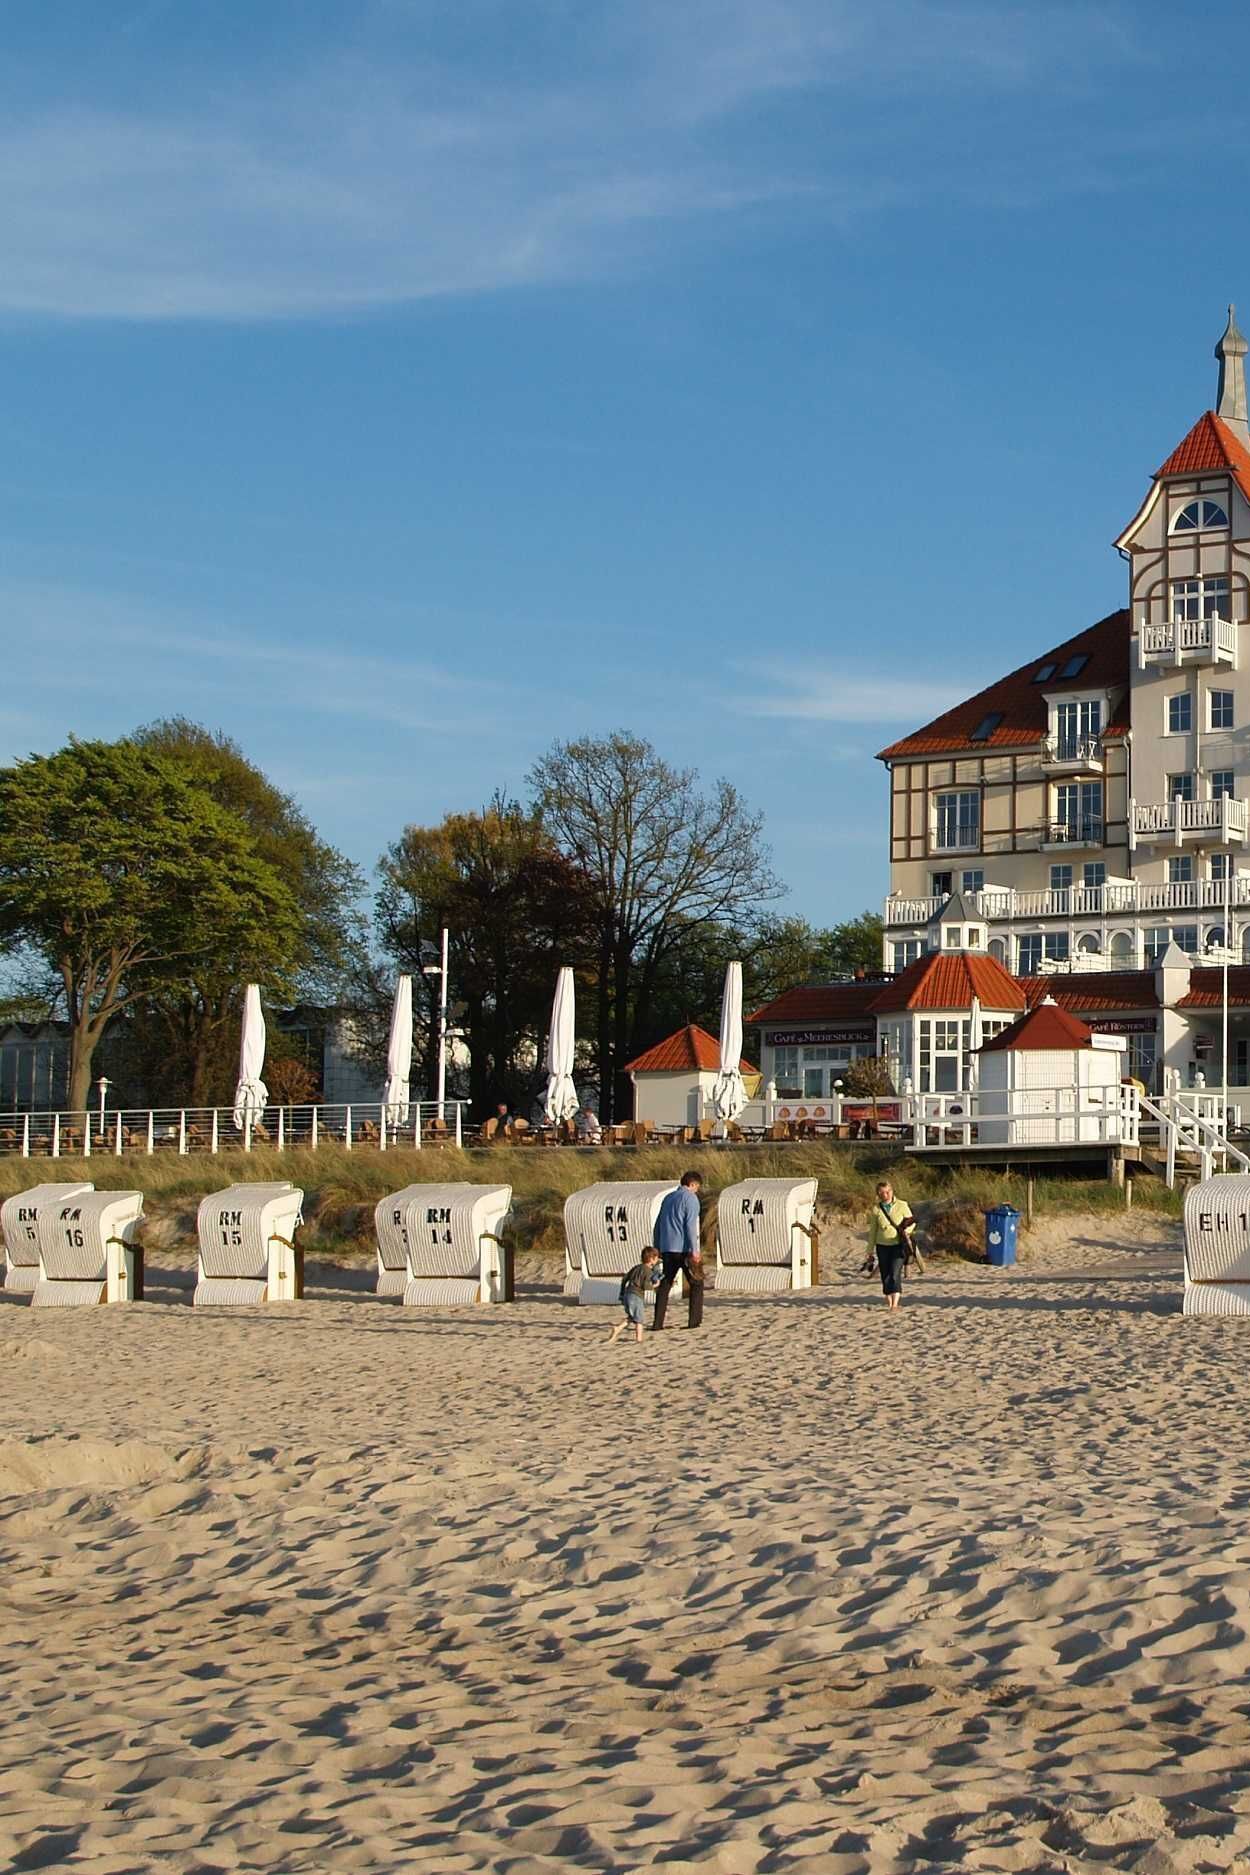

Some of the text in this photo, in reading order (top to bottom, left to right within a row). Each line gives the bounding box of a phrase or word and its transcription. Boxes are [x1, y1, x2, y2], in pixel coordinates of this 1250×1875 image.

[19, 1208, 37, 1221] RM
[60, 1207, 82, 1221] RM
[605, 1206, 628, 1222] RM
[741, 1199, 764, 1215] RM
[219, 1211, 241, 1226] RM
[427, 1208, 451, 1223] RM
[1200, 1213, 1229, 1232] EH
[748, 1218, 755, 1233] 1
[26, 1227, 36, 1240] 5
[65, 1229, 84, 1247] 16
[222, 1231, 241, 1245] 15
[431, 1229, 452, 1244] 14
[607, 1226, 628, 1242] 13
